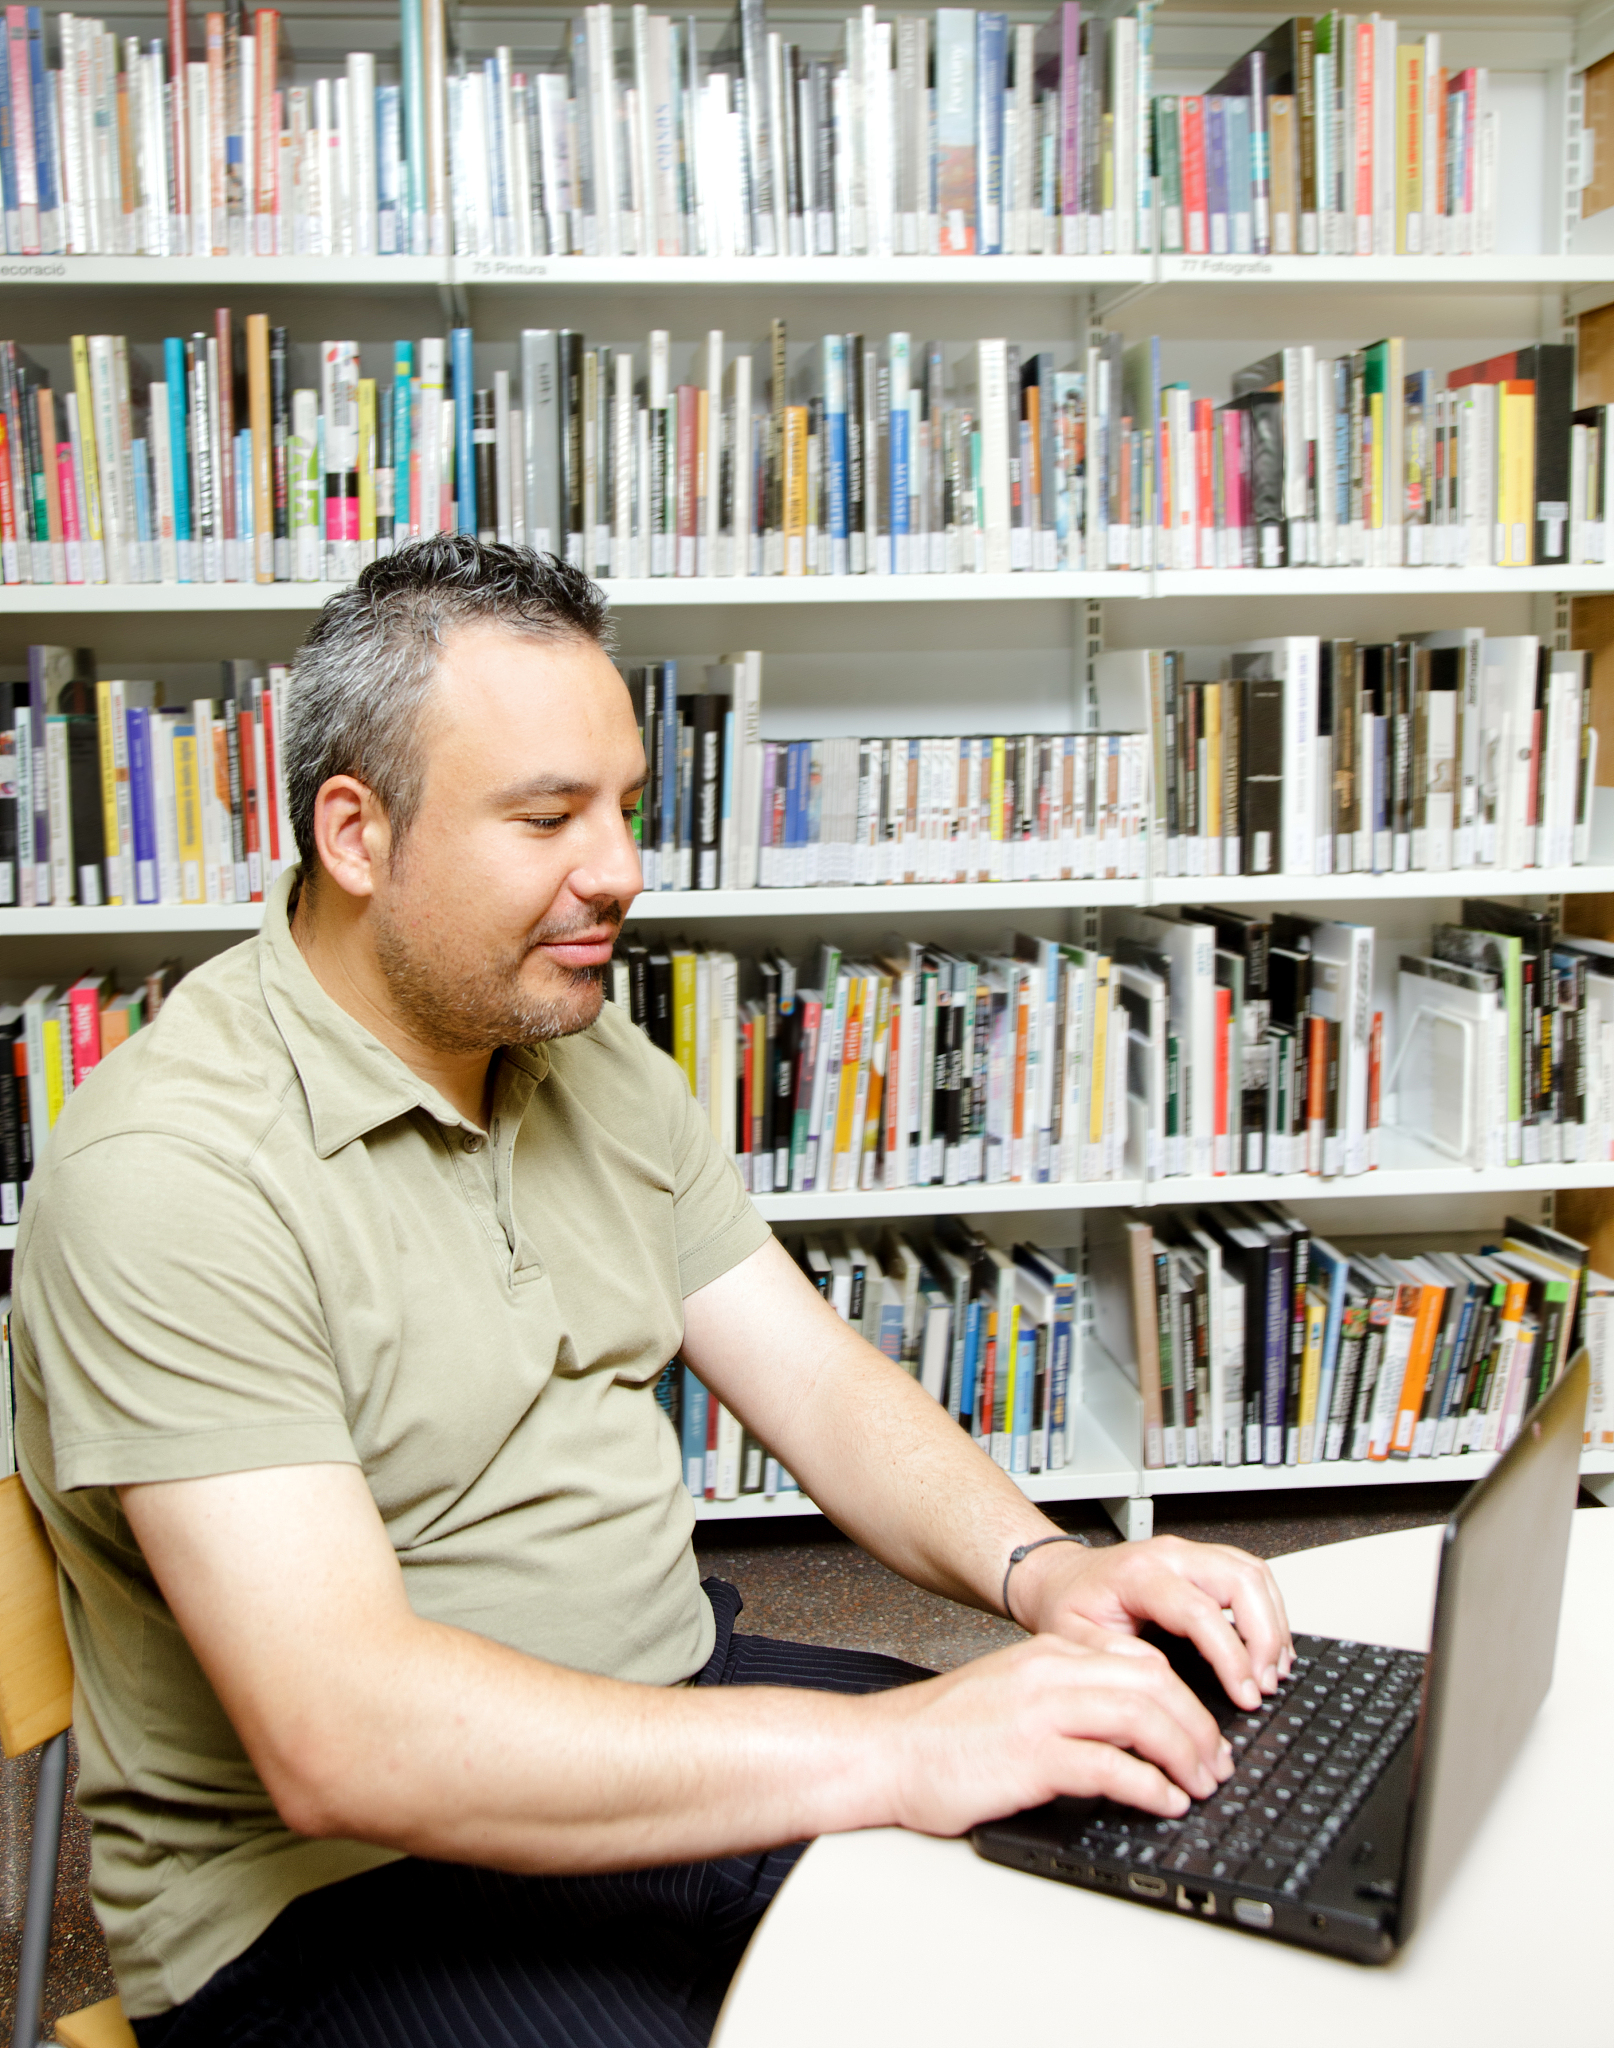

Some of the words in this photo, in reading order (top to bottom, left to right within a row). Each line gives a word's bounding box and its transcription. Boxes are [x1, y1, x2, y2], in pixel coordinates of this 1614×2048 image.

[946, 46, 966, 113] Fortuny
[0, 262, 66, 276] ecoració
[494, 261, 547, 275] Pintura
[1180, 259, 1199, 272] 77
[877, 366, 889, 424] MATISSE
[1010, 458, 1020, 483] joan
[831, 461, 843, 531] MAGRITTE
[895, 463, 907, 523] MATISSE
[646, 685, 654, 716] RIBERA
[703, 731, 718, 780] saura
[721, 974, 736, 1021] Vuillard
[76, 1003, 92, 1045] 300%
[682, 1003, 694, 1042] Vermeer
[844, 1021, 860, 1061] artista
[935, 1054, 946, 1090] FORMA
[950, 1050, 962, 1090] ESPACIO
[1270, 1267, 1284, 1343] NATURALEZA
[1492, 1376, 1508, 1412] digitales
